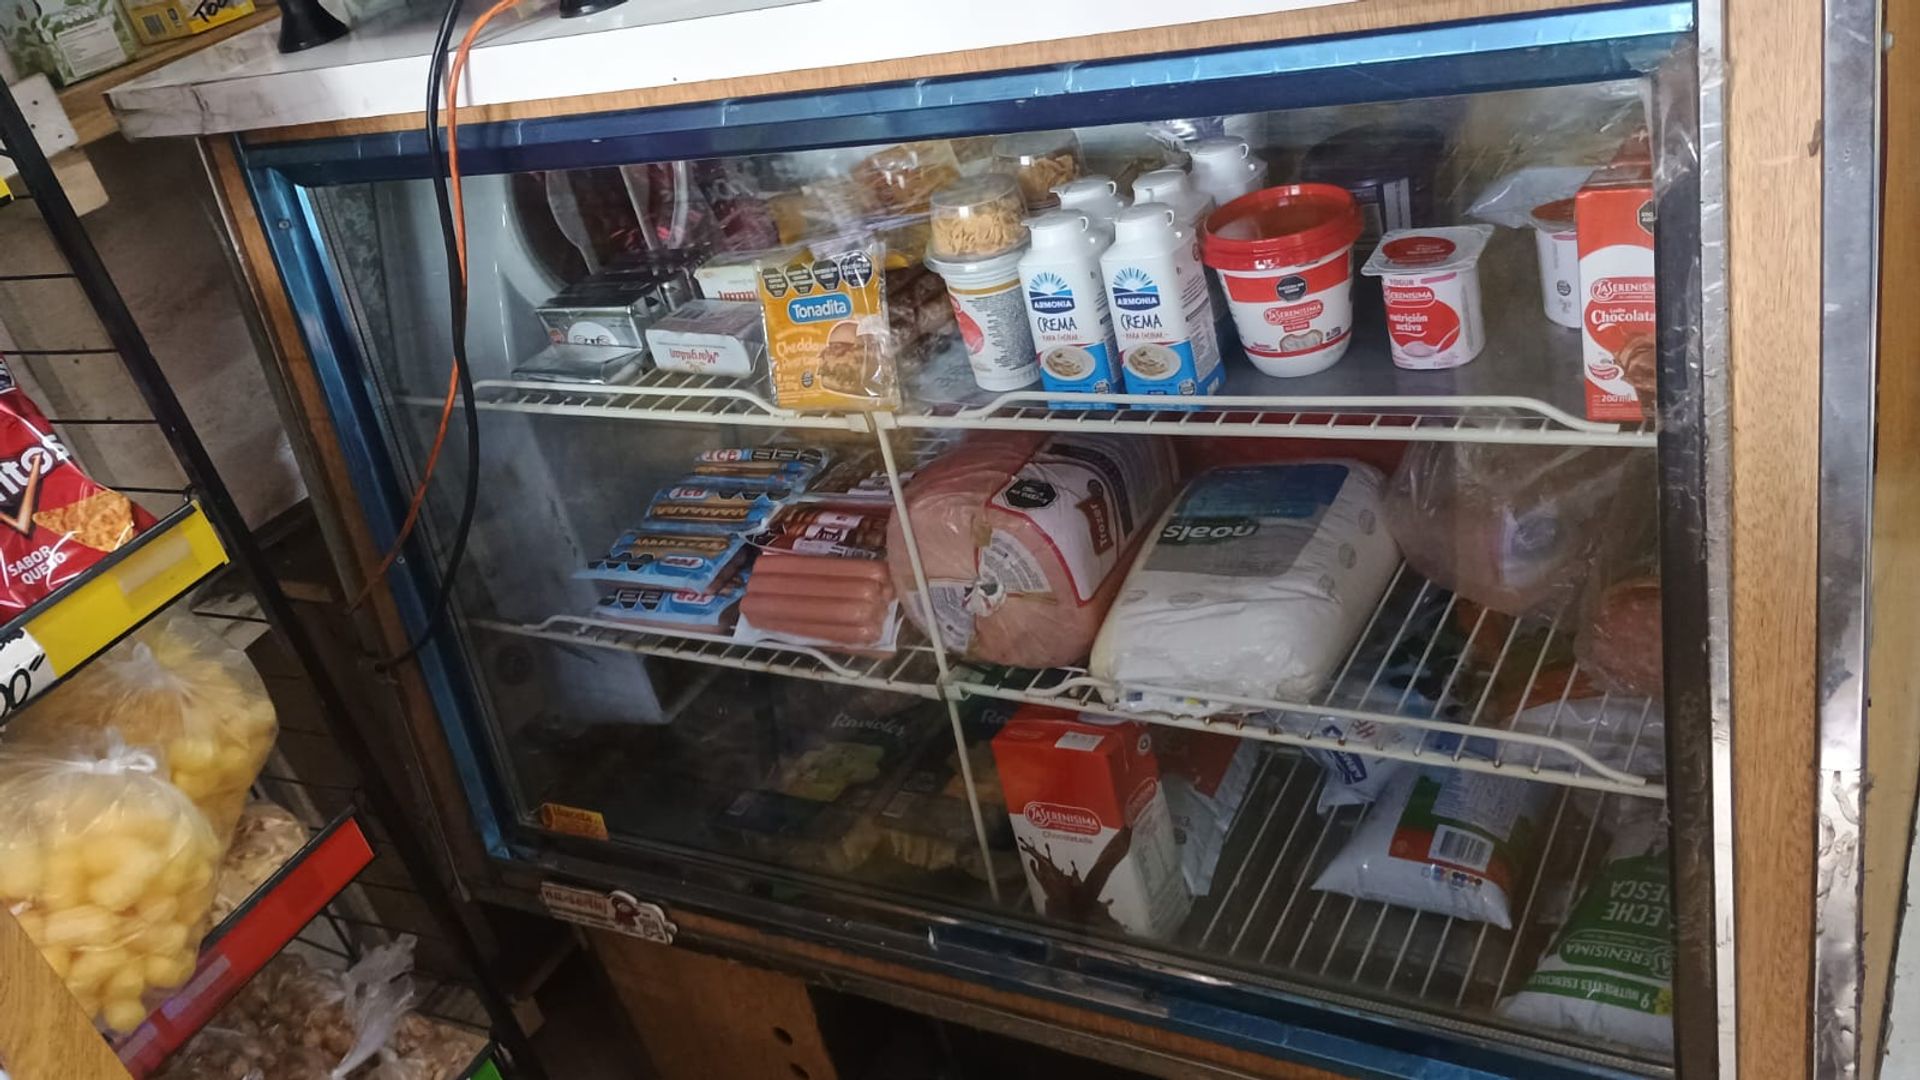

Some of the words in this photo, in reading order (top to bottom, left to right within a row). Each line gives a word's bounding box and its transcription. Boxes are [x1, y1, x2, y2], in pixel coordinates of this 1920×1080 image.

[792, 299, 848, 319] Tonadita
[1034, 300, 1072, 309] ARMONIA
[1117, 297, 1158, 305] ARMONIA
[1037, 316, 1077, 333] CREMA
[1120, 313, 1162, 331] CREMA
[1389, 312, 1428, 322] nutrición
[1395, 323, 1422, 331] activa
[0, 434, 71, 502] itos
[7, 545, 51, 577] SABOR
[1610, 880, 1667, 904] ESCA
[1600, 901, 1664, 926] ECHE
[1640, 992, 1651, 1009] 9
